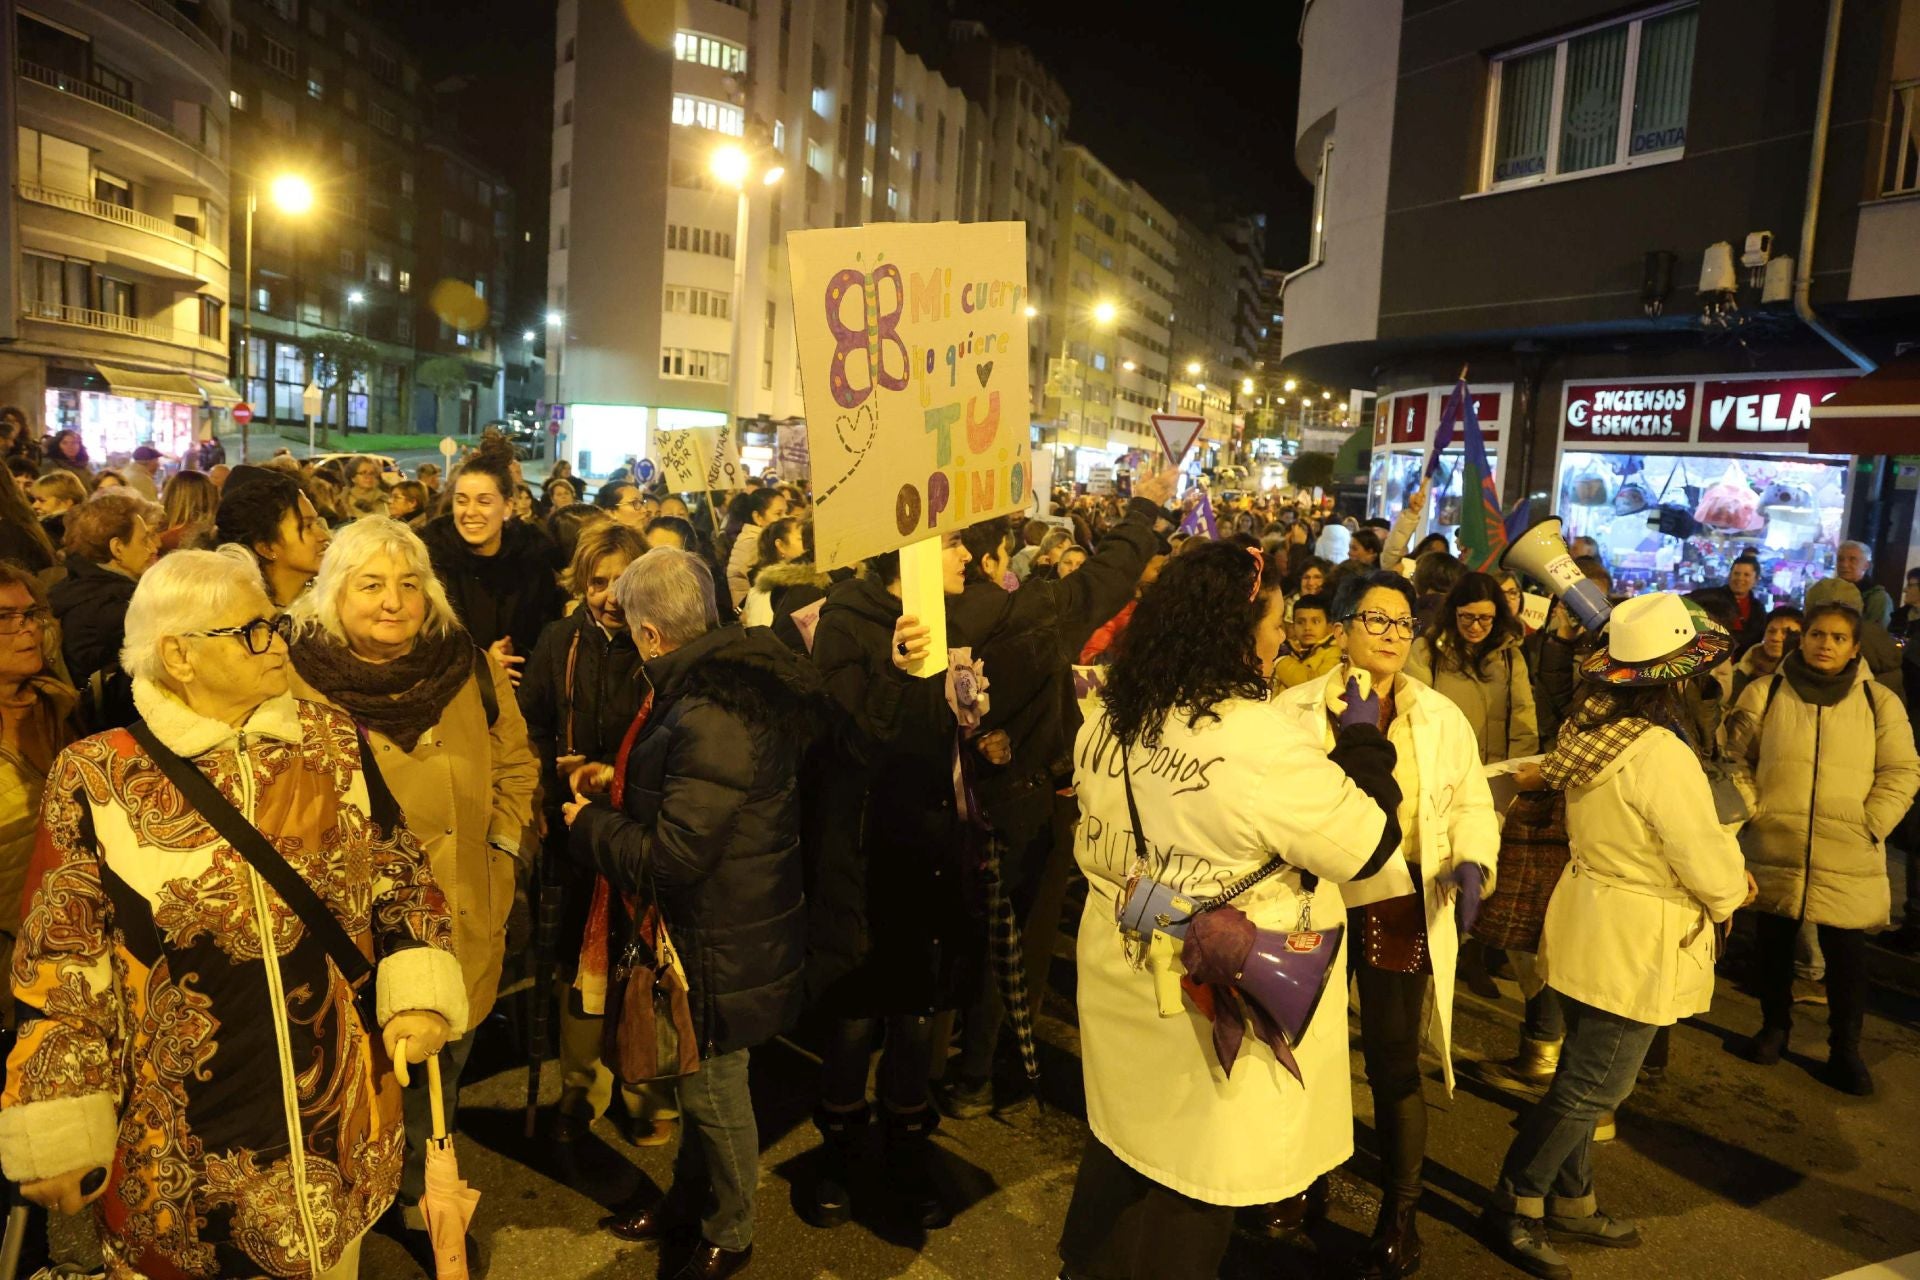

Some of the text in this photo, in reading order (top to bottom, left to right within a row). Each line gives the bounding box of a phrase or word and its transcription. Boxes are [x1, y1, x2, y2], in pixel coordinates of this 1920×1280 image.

[946, 331, 1009, 387] quiere
[1593, 389, 1686, 412] INCIENSOS
[657, 431, 671, 449] NO
[924, 391, 1000, 469] TU
[662, 429, 690, 468] DECIDAS
[673, 448, 692, 472] POR
[678, 468, 693, 484] MI
